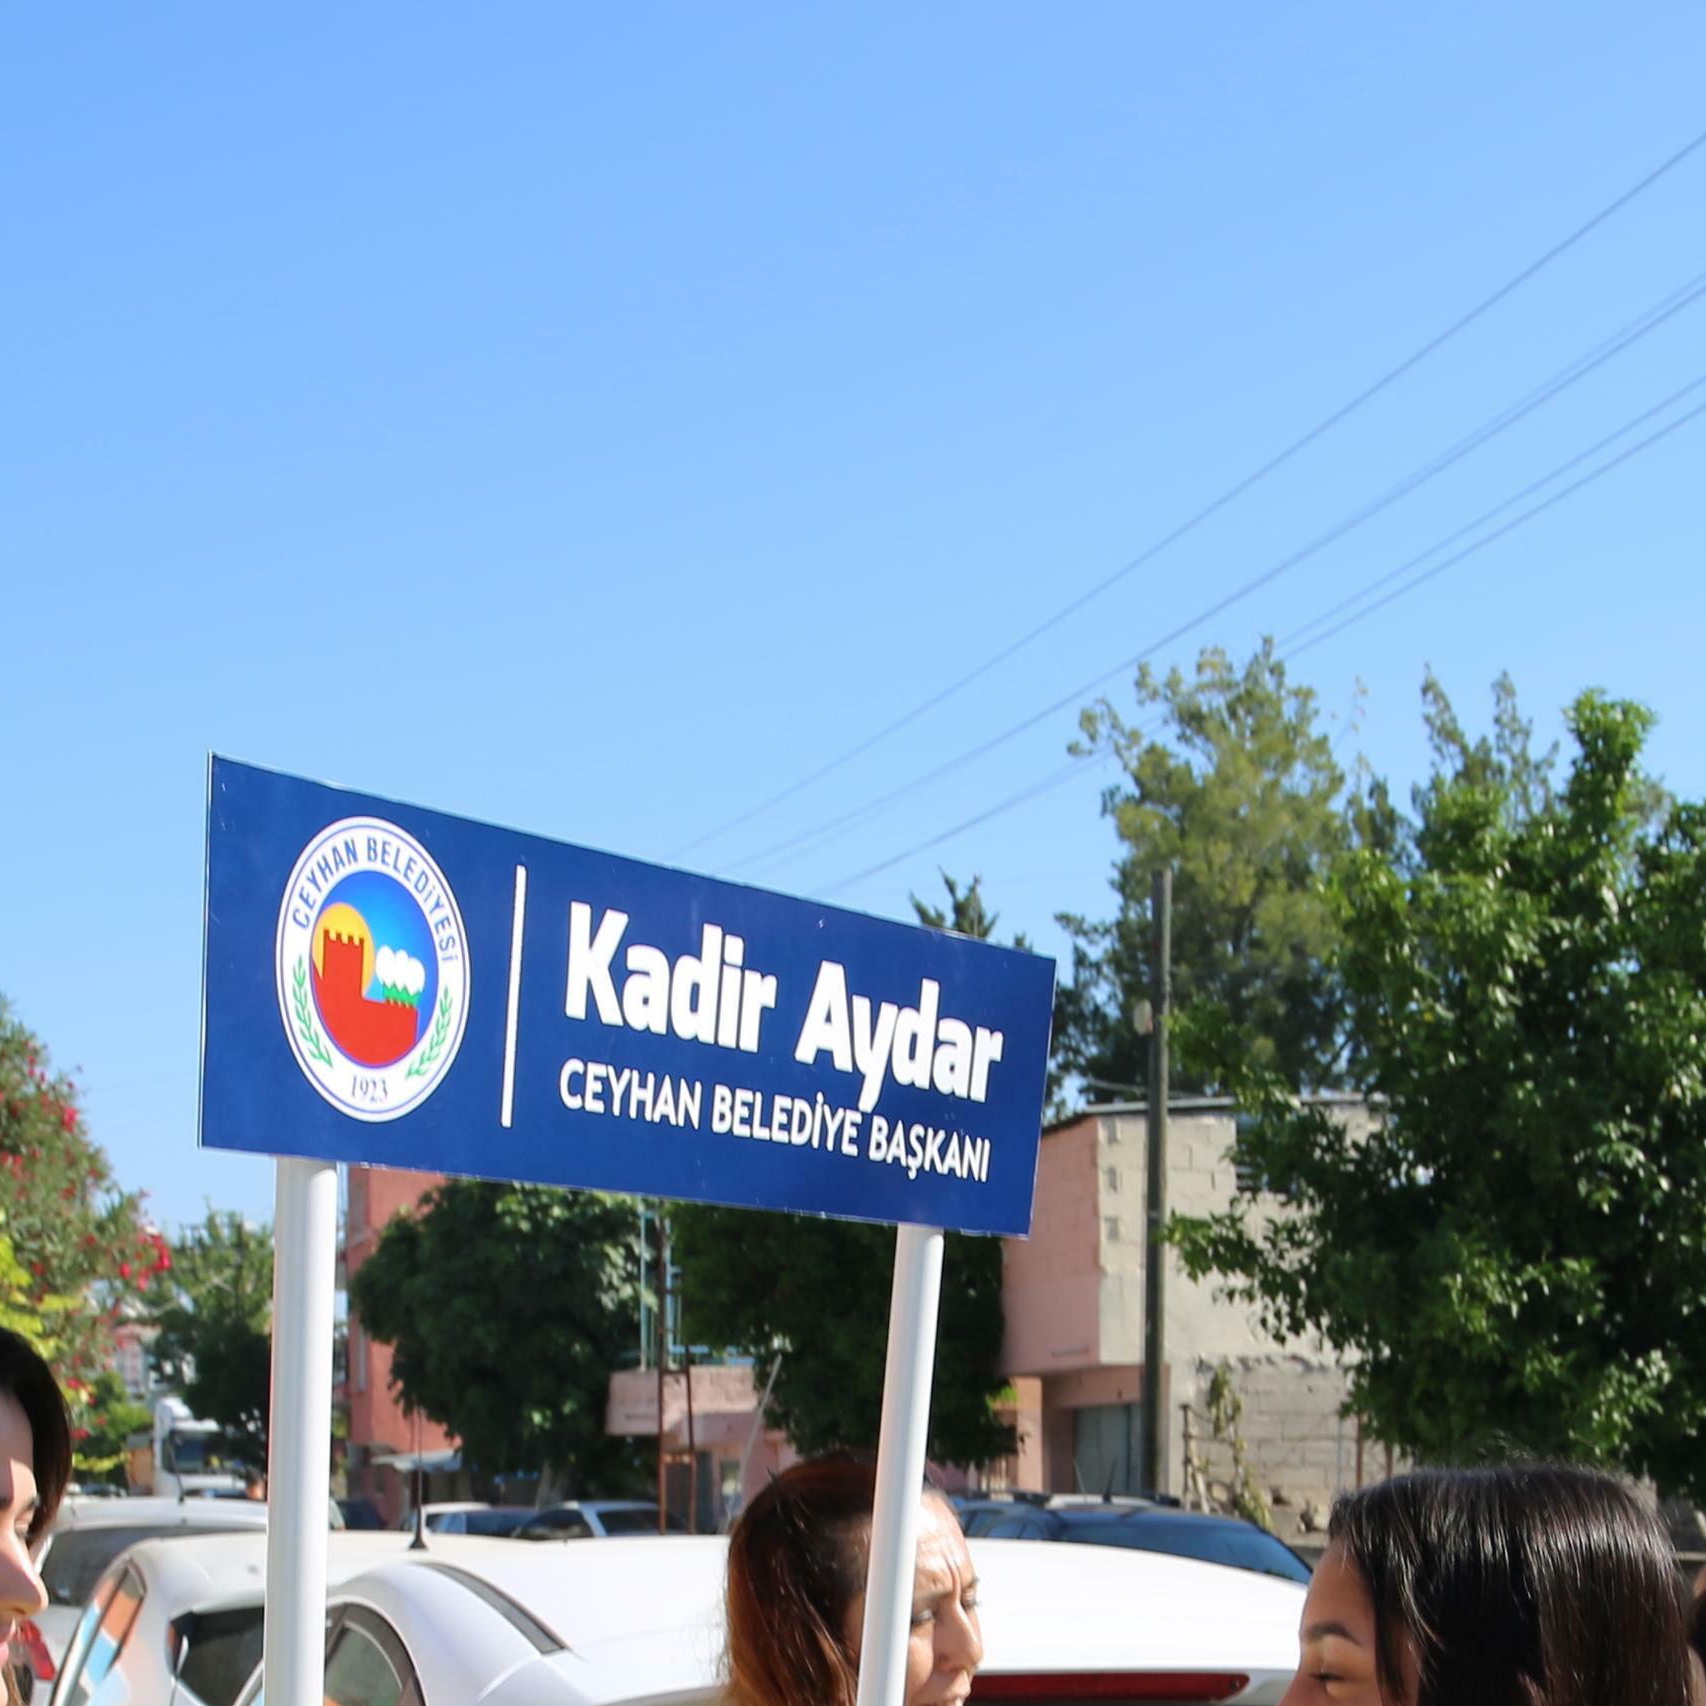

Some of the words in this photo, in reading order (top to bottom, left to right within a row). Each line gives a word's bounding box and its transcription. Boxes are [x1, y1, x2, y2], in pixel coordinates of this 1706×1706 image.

[292, 837, 359, 930] CEYHAN
[564, 900, 778, 1053] Kadir
[794, 959, 1005, 1114] Aydar
[350, 1073, 389, 1104] 1923
[559, 1057, 703, 1130] CEYHAN
[710, 1083, 863, 1157] BELEDİYE
[868, 1114, 991, 1183] BAŞKANI
